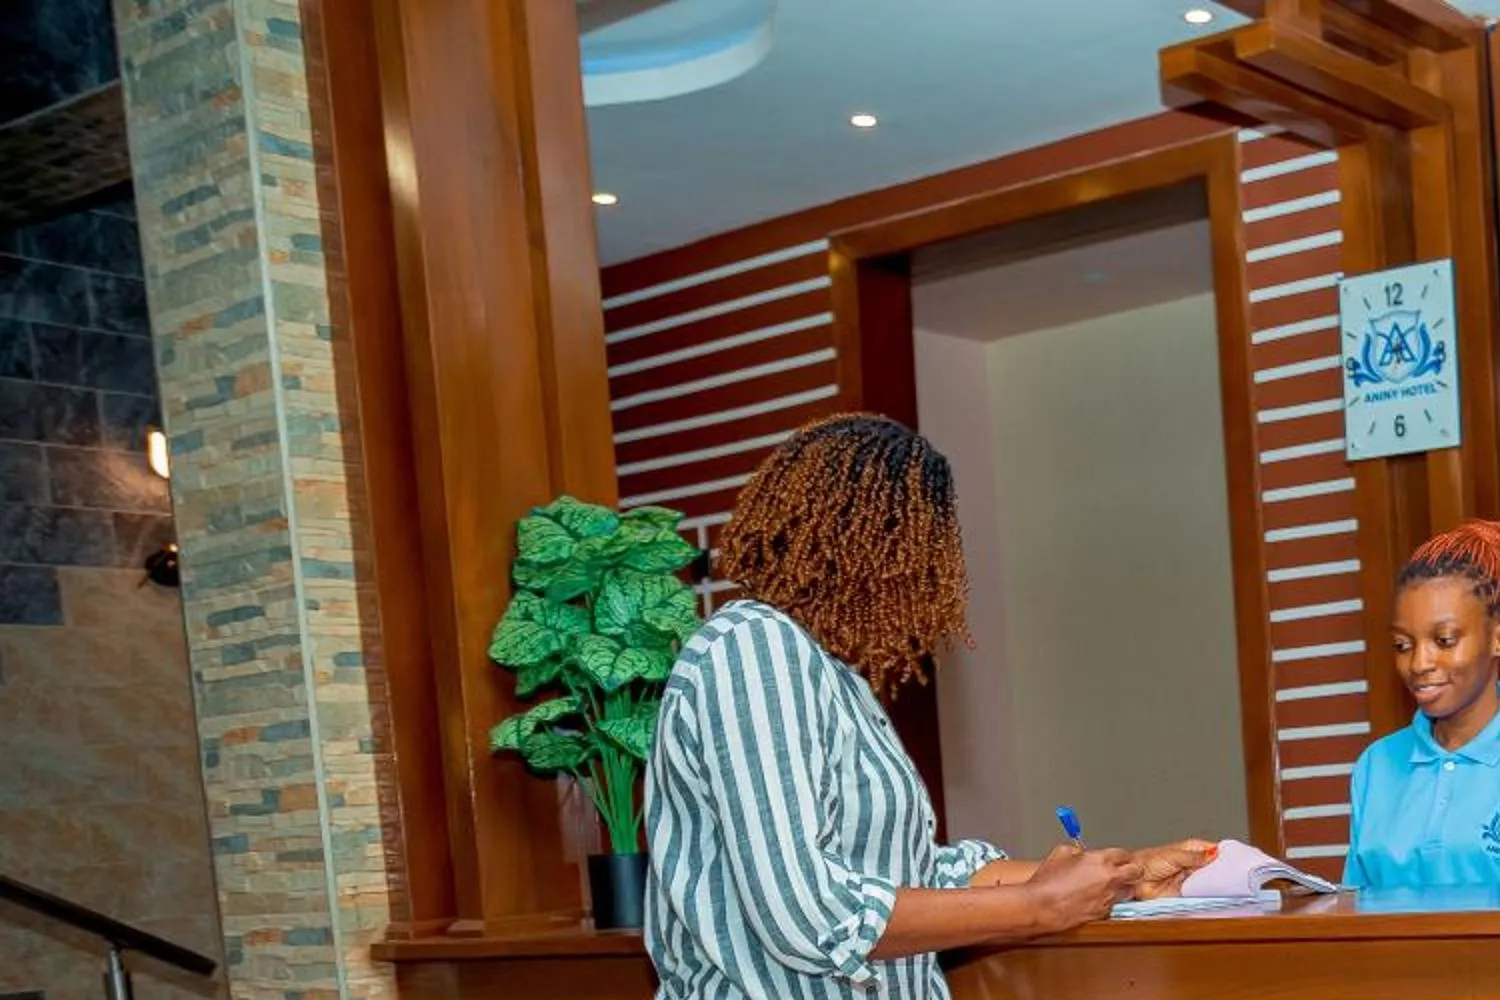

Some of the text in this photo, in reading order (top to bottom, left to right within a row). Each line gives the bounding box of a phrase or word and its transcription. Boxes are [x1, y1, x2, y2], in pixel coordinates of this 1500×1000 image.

[1384, 282, 1404, 307] 12
[1401, 383, 1438, 399] HOTEL
[1394, 414, 1406, 437] 6
